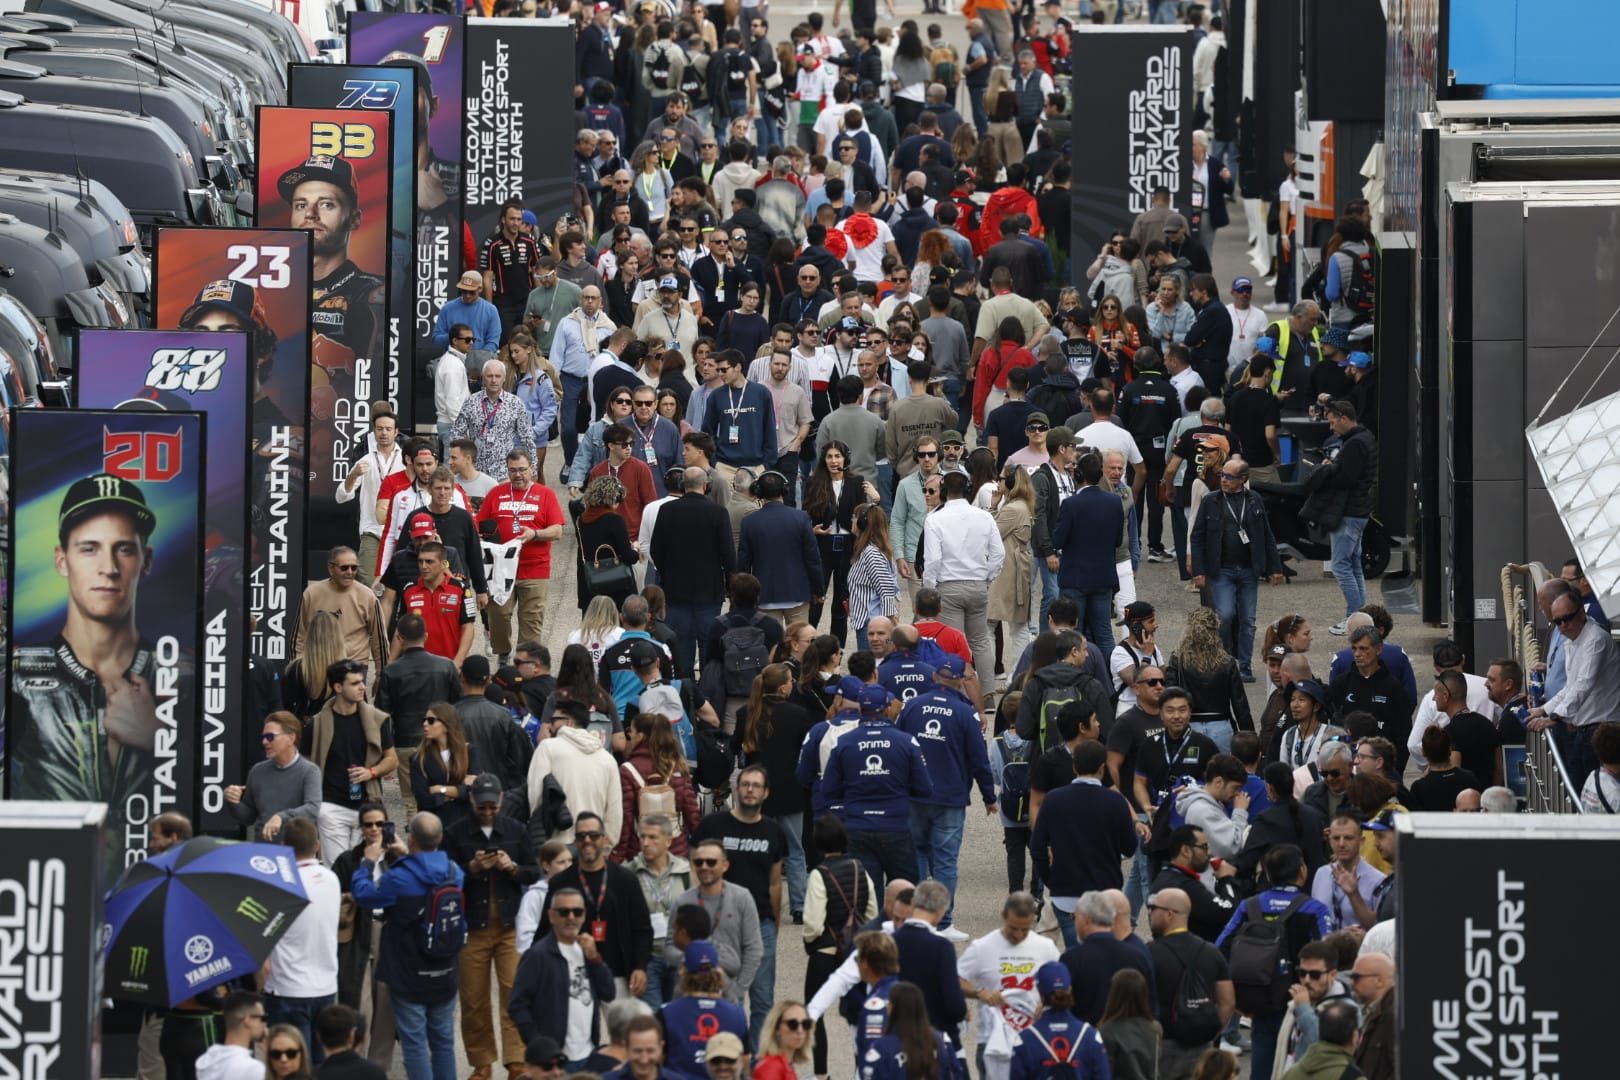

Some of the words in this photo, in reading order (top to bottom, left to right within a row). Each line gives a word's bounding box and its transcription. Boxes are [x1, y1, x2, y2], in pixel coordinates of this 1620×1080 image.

[423, 26, 452, 64] 1
[496, 39, 509, 109] SPORT
[336, 80, 400, 109] 79
[481, 60, 494, 128] MOST
[311, 121, 376, 159] 33
[466, 97, 480, 205] WELCOME
[481, 131, 494, 173] THE
[495, 112, 509, 206] EXCITING
[510, 102, 523, 172] EARTH
[1129, 90, 1146, 214] FASTER
[481, 176, 494, 206] TO
[227, 245, 291, 289] 23
[416, 244, 432, 337] JORGE
[433, 226, 450, 324] ARTIN
[145, 348, 228, 394] 88
[353, 358, 371, 448] NDER
[103, 424, 183, 483] 20
[333, 398, 350, 482] BRAD
[267, 425, 290, 660] BASTIANINI
[57, 645, 88, 680] YAMAHA
[895, 673, 925, 684] prima
[153, 635, 180, 815] TARARO
[203, 608, 227, 814] OLIVEIRA
[922, 704, 953, 717] prima
[858, 739, 891, 751] prima
[739, 837, 769, 854] 1000
[184, 956, 232, 985] YAMAHA
[1498, 869, 1525, 1025] SPORT
[1465, 917, 1493, 1068] MOST
